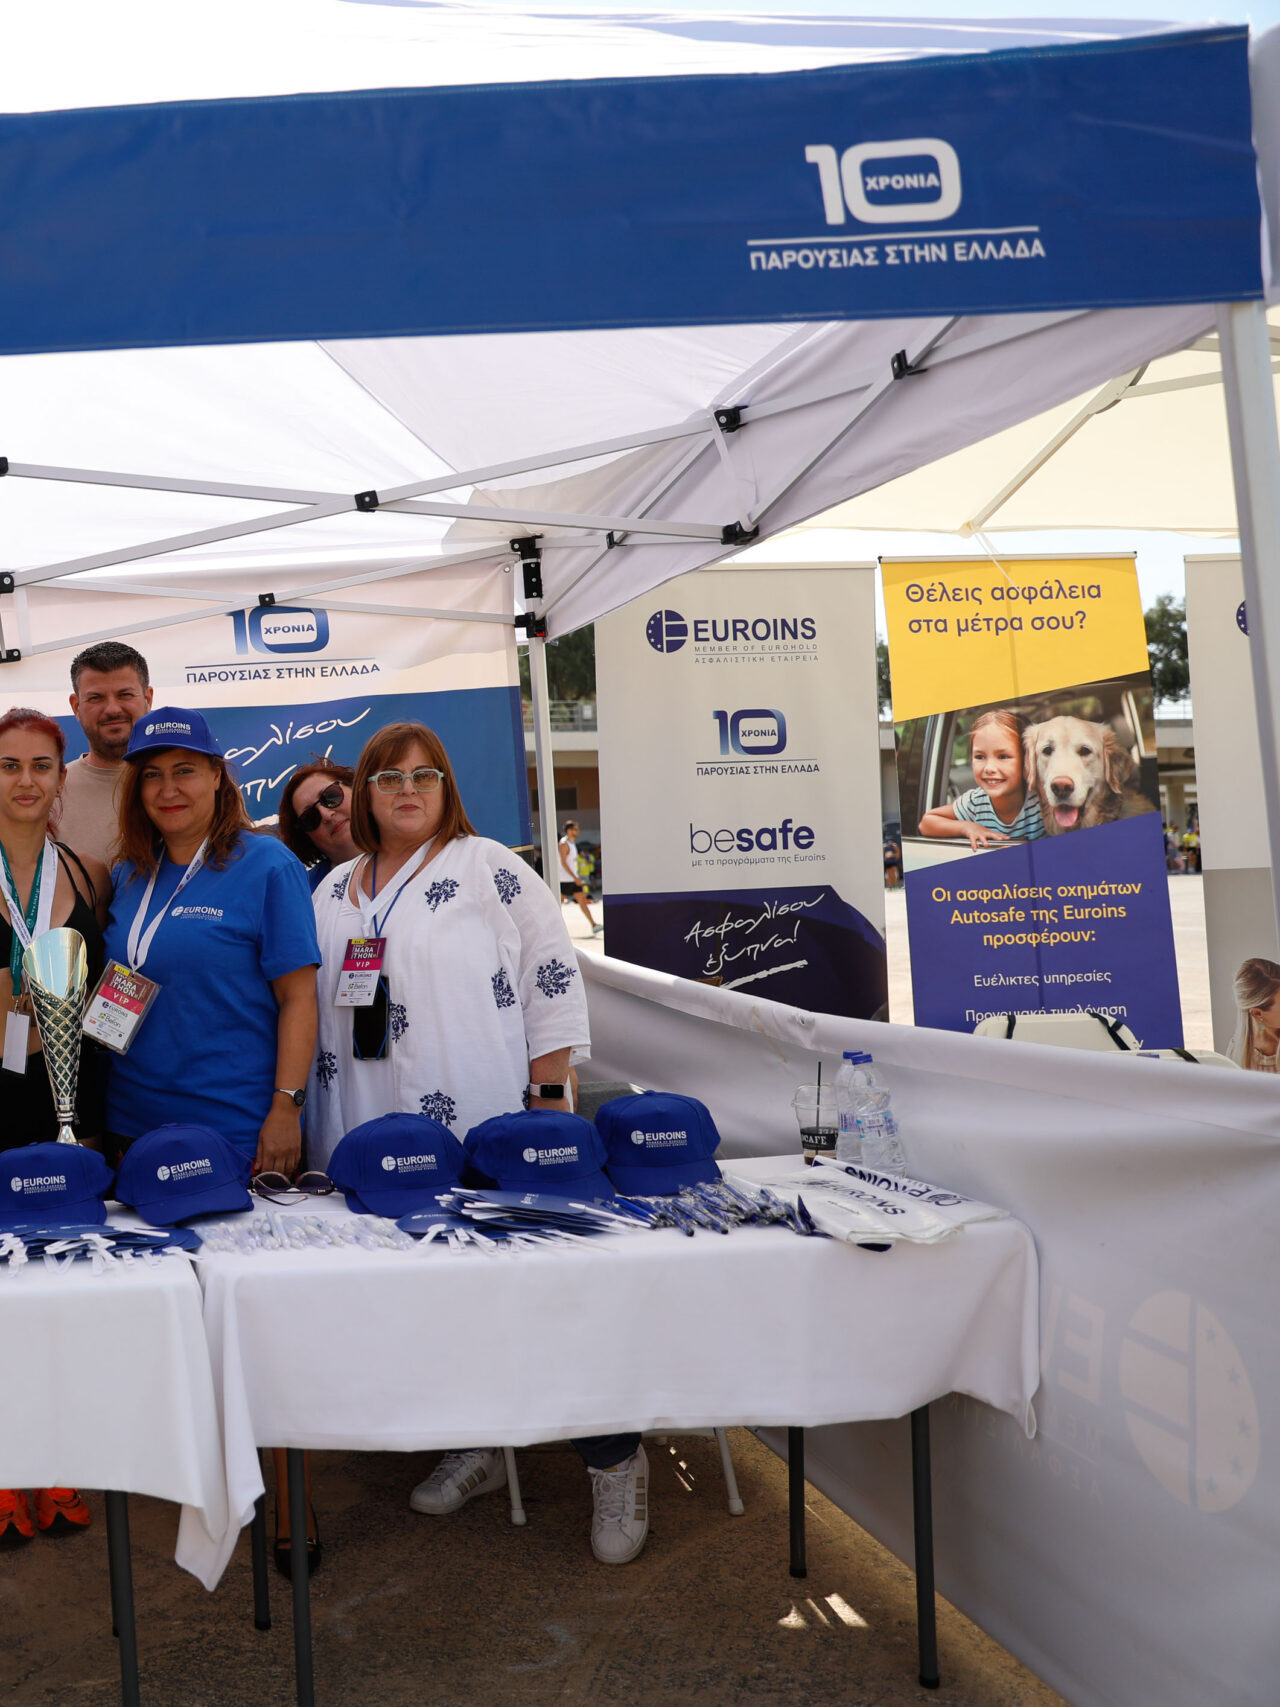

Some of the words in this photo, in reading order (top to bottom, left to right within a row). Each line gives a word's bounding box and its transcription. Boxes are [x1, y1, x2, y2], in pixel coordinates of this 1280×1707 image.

[805, 138, 962, 225] 10
[865, 172, 940, 190] ΧΡΟΝΙΑ
[750, 247, 879, 271] ΠΑΡΟΥΣΙΑΣ
[885, 243, 947, 265] ΣΤΗΝ
[953, 238, 1046, 262] ΕΛΛΑΔΑ
[905, 582, 983, 605] Θέλεις
[990, 579, 1102, 605] ασφάλεια
[226, 606, 329, 656] 10
[264, 622, 316, 635] ΧΡΟΝΙΑ
[694, 618, 817, 642] EUROINS
[908, 619, 948, 634] στα
[956, 612, 1023, 637] μέτρα
[1031, 610, 1087, 631] σου?
[695, 645, 738, 653] MEMBER
[743, 644, 756, 652] OF
[761, 643, 818, 652] EUROHOLD
[186, 667, 271, 683] ΠΑΡΟΥΣΙΑΣ
[276, 666, 316, 680] ΣΤΗΝ
[320, 663, 380, 678] ΕΛΛΑΔΑ
[155, 721, 191, 731] EUROINS
[713, 709, 787, 756] 10
[740, 729, 777, 738] ΧΡΟΝΙΑ
[696, 765, 751, 776] ΠΑΡΟΥΣΙΑΣ
[753, 764, 779, 775] ΣΤΗΝ
[781, 763, 820, 774] ΕΛΛΑΔΑ
[689, 818, 815, 854] besafe
[691, 859, 703, 867] με
[704, 858, 714, 867] τα
[716, 855, 775, 867] προγράμματα
[777, 855, 791, 864] της
[794, 853, 826, 862] Euroins
[932, 887, 952, 902] Οι
[956, 884, 1052, 903] ασφαλίσεις
[1058, 880, 1142, 900] οχημάτων
[183, 906, 224, 917] EUROINS
[950, 906, 1025, 925] Autosafe
[1030, 909, 1058, 924] της
[1063, 903, 1127, 921] Euroins
[983, 928, 1096, 949] προσφέρουν:
[114, 975, 137, 991] MARA
[973, 972, 1040, 988] Ευέλικτες
[1043, 970, 1112, 986] υπηρεσίες
[113, 992, 130, 1005] VIP
[645, 1130, 687, 1141] EUROINS
[396, 1154, 436, 1167] EUROINS
[537, 1145, 578, 1159] EUROINS
[170, 1158, 211, 1174] EUROINS
[23, 1175, 66, 1187] EUROINS
